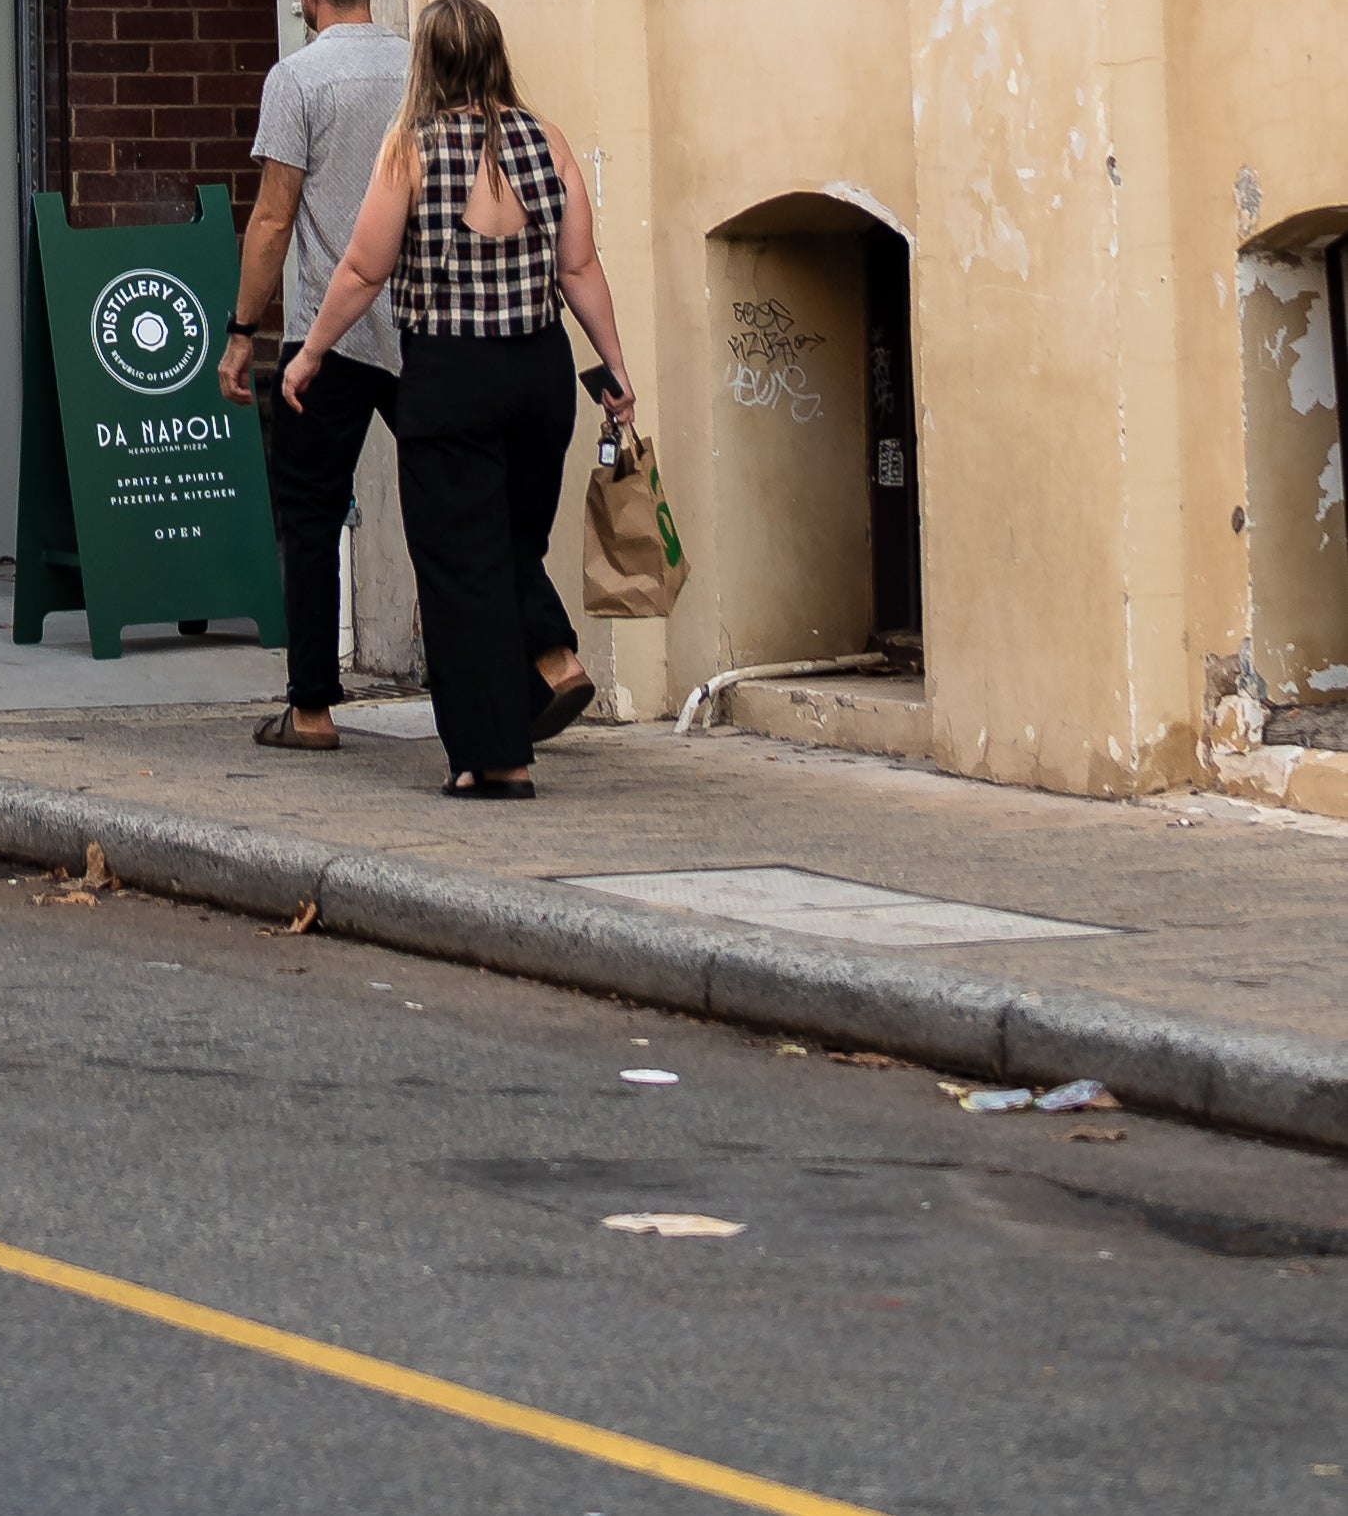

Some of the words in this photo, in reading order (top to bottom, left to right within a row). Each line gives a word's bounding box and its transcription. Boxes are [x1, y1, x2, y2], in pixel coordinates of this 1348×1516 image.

[102, 279, 174, 344] DISTILLERY
[172, 296, 198, 338] BAR
[110, 349, 145, 380] REPUBLIC
[146, 372, 158, 381] OF
[160, 344, 195, 381] FREMANTLE
[96, 422, 128, 447] DA
[140, 414, 231, 445] NAPOLI
[128, 445, 181, 456] NEAPOLITAN
[183, 442, 209, 451] PIZZA
[117, 475, 158, 488] SPRITZ
[164, 475, 172, 485] &
[177, 471, 224, 484] SPIRITS
[110, 492, 165, 506] PIZZERIA
[170, 491, 179, 501] &
[184, 487, 237, 500] KITCHEN
[154, 525, 202, 540] OPEN
